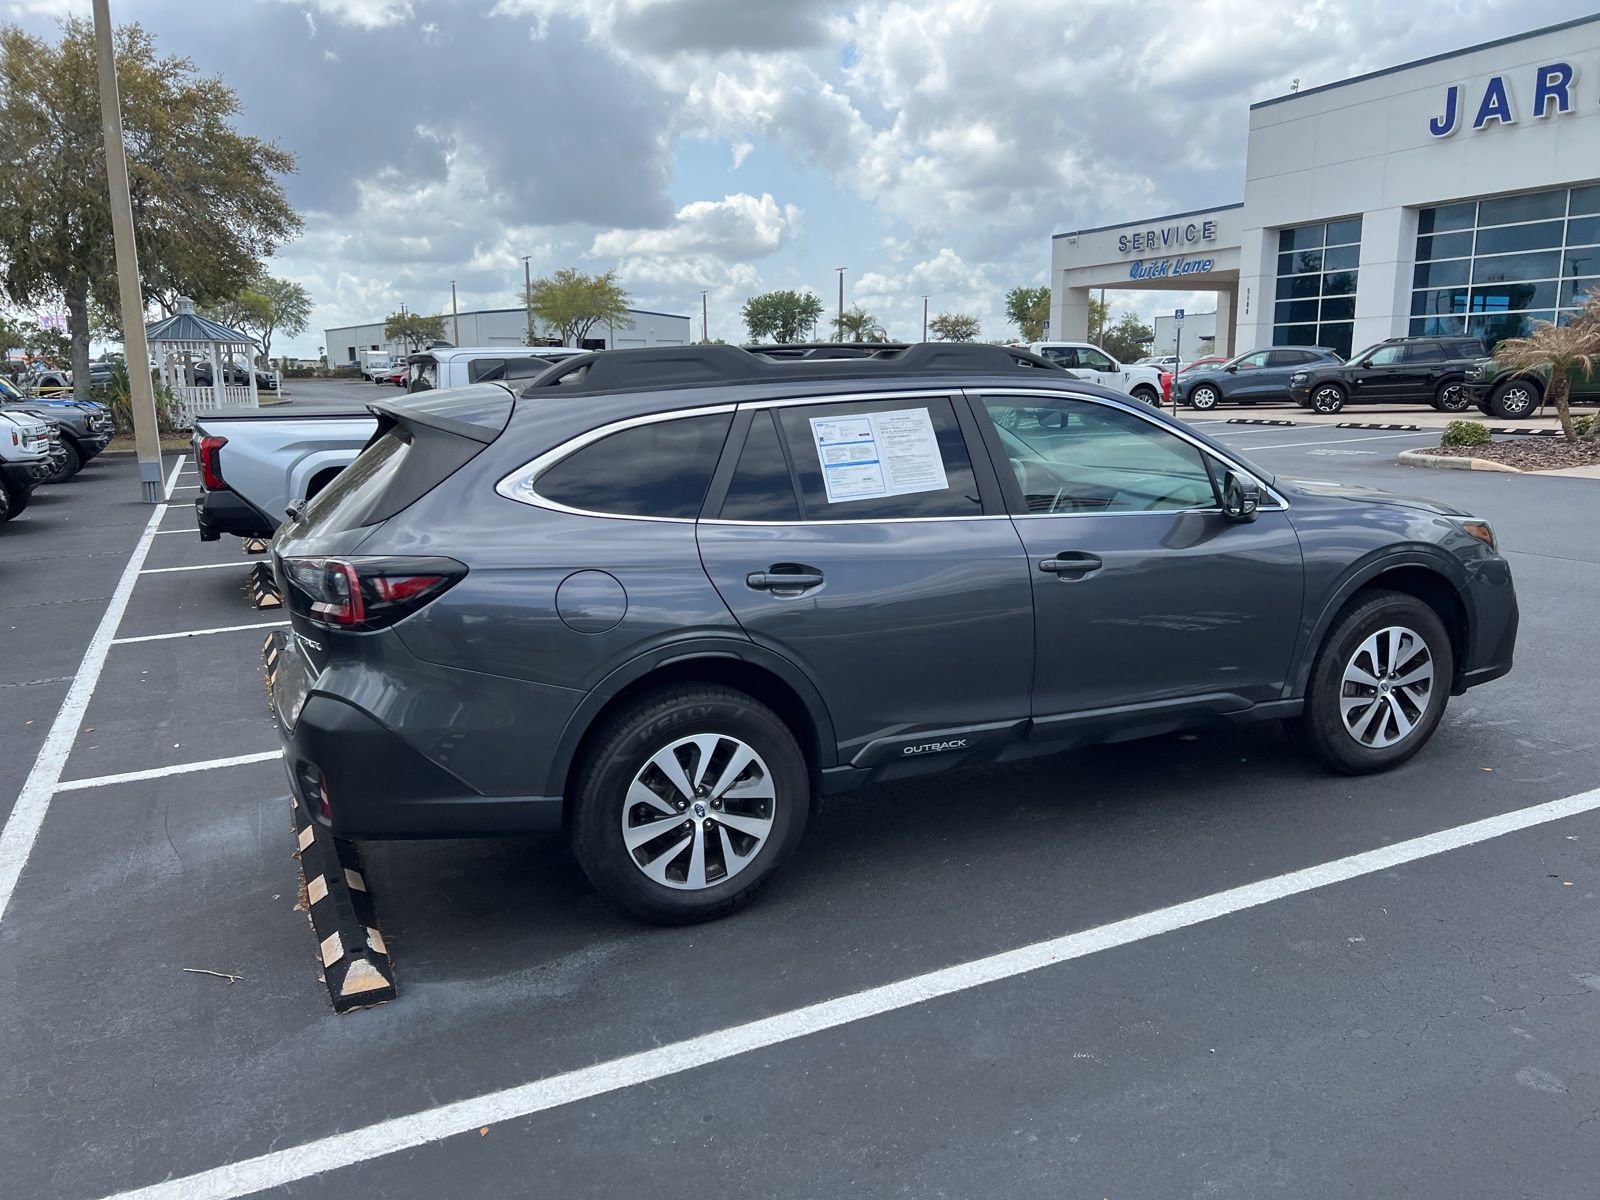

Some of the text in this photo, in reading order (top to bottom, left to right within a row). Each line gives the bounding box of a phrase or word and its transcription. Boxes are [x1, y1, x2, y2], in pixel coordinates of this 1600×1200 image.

[1429, 60, 1600, 139] JAR
[1118, 220, 1216, 254] SERVICE
[1129, 257, 1214, 281] Quick Lane
[903, 739, 967, 755] OUTBACK
